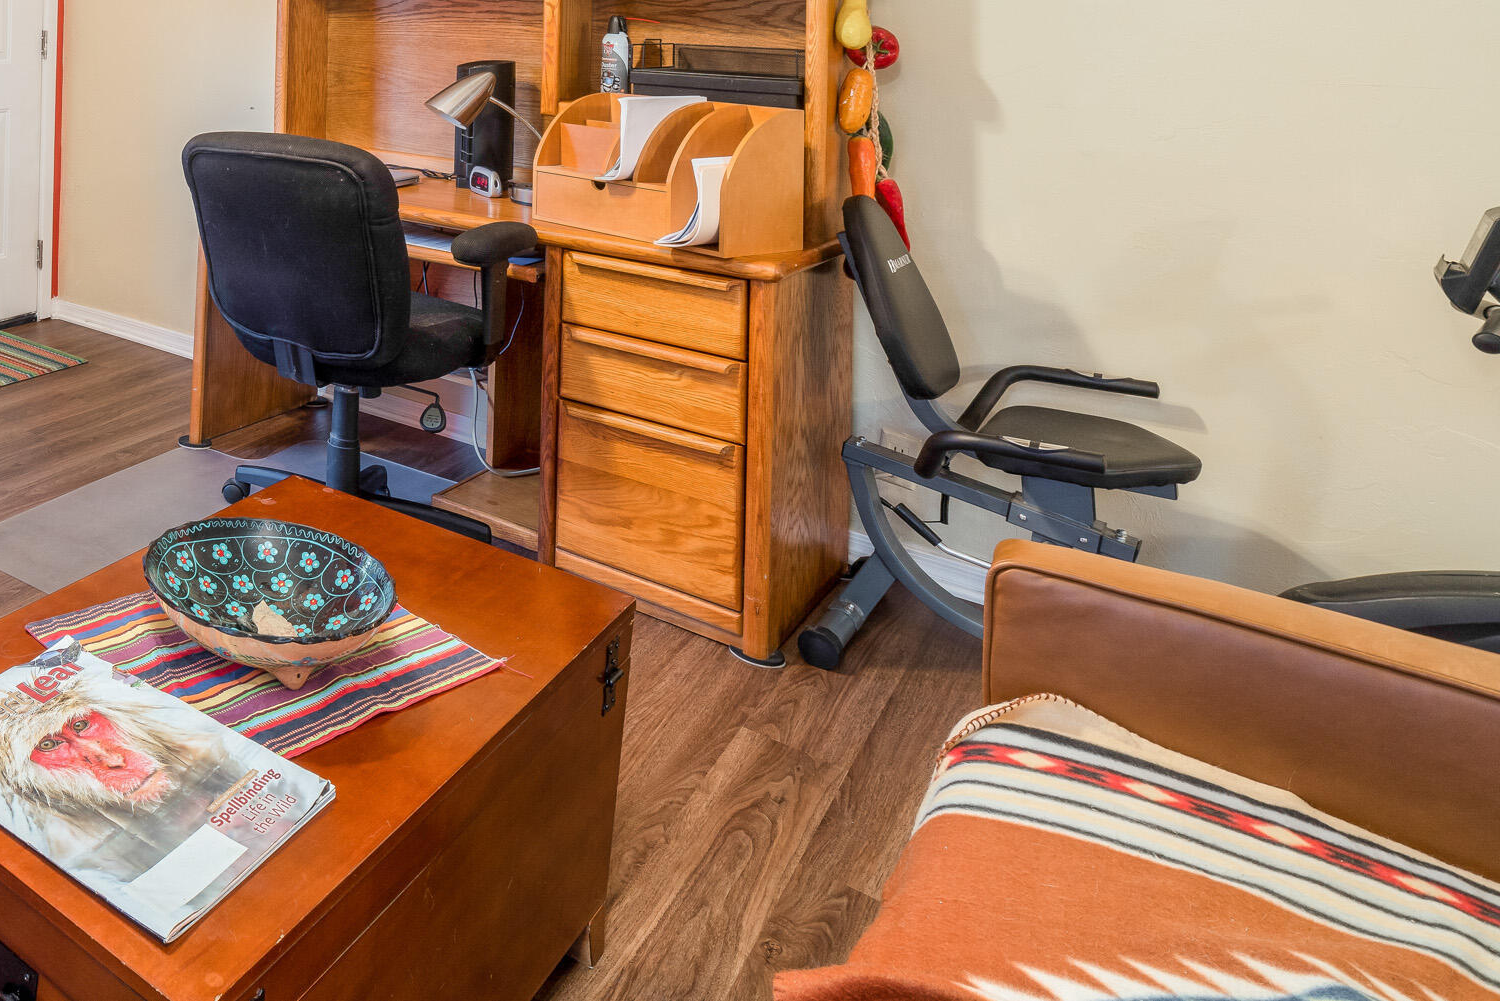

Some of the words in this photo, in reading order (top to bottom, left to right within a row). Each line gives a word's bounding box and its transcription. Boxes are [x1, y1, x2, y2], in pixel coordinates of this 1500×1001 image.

[210, 768, 282, 827] Spellbinding
[241, 802, 267, 822] Life
[258, 793, 277, 808] in
[253, 817, 276, 834] the
[268, 793, 297, 818] Wild
